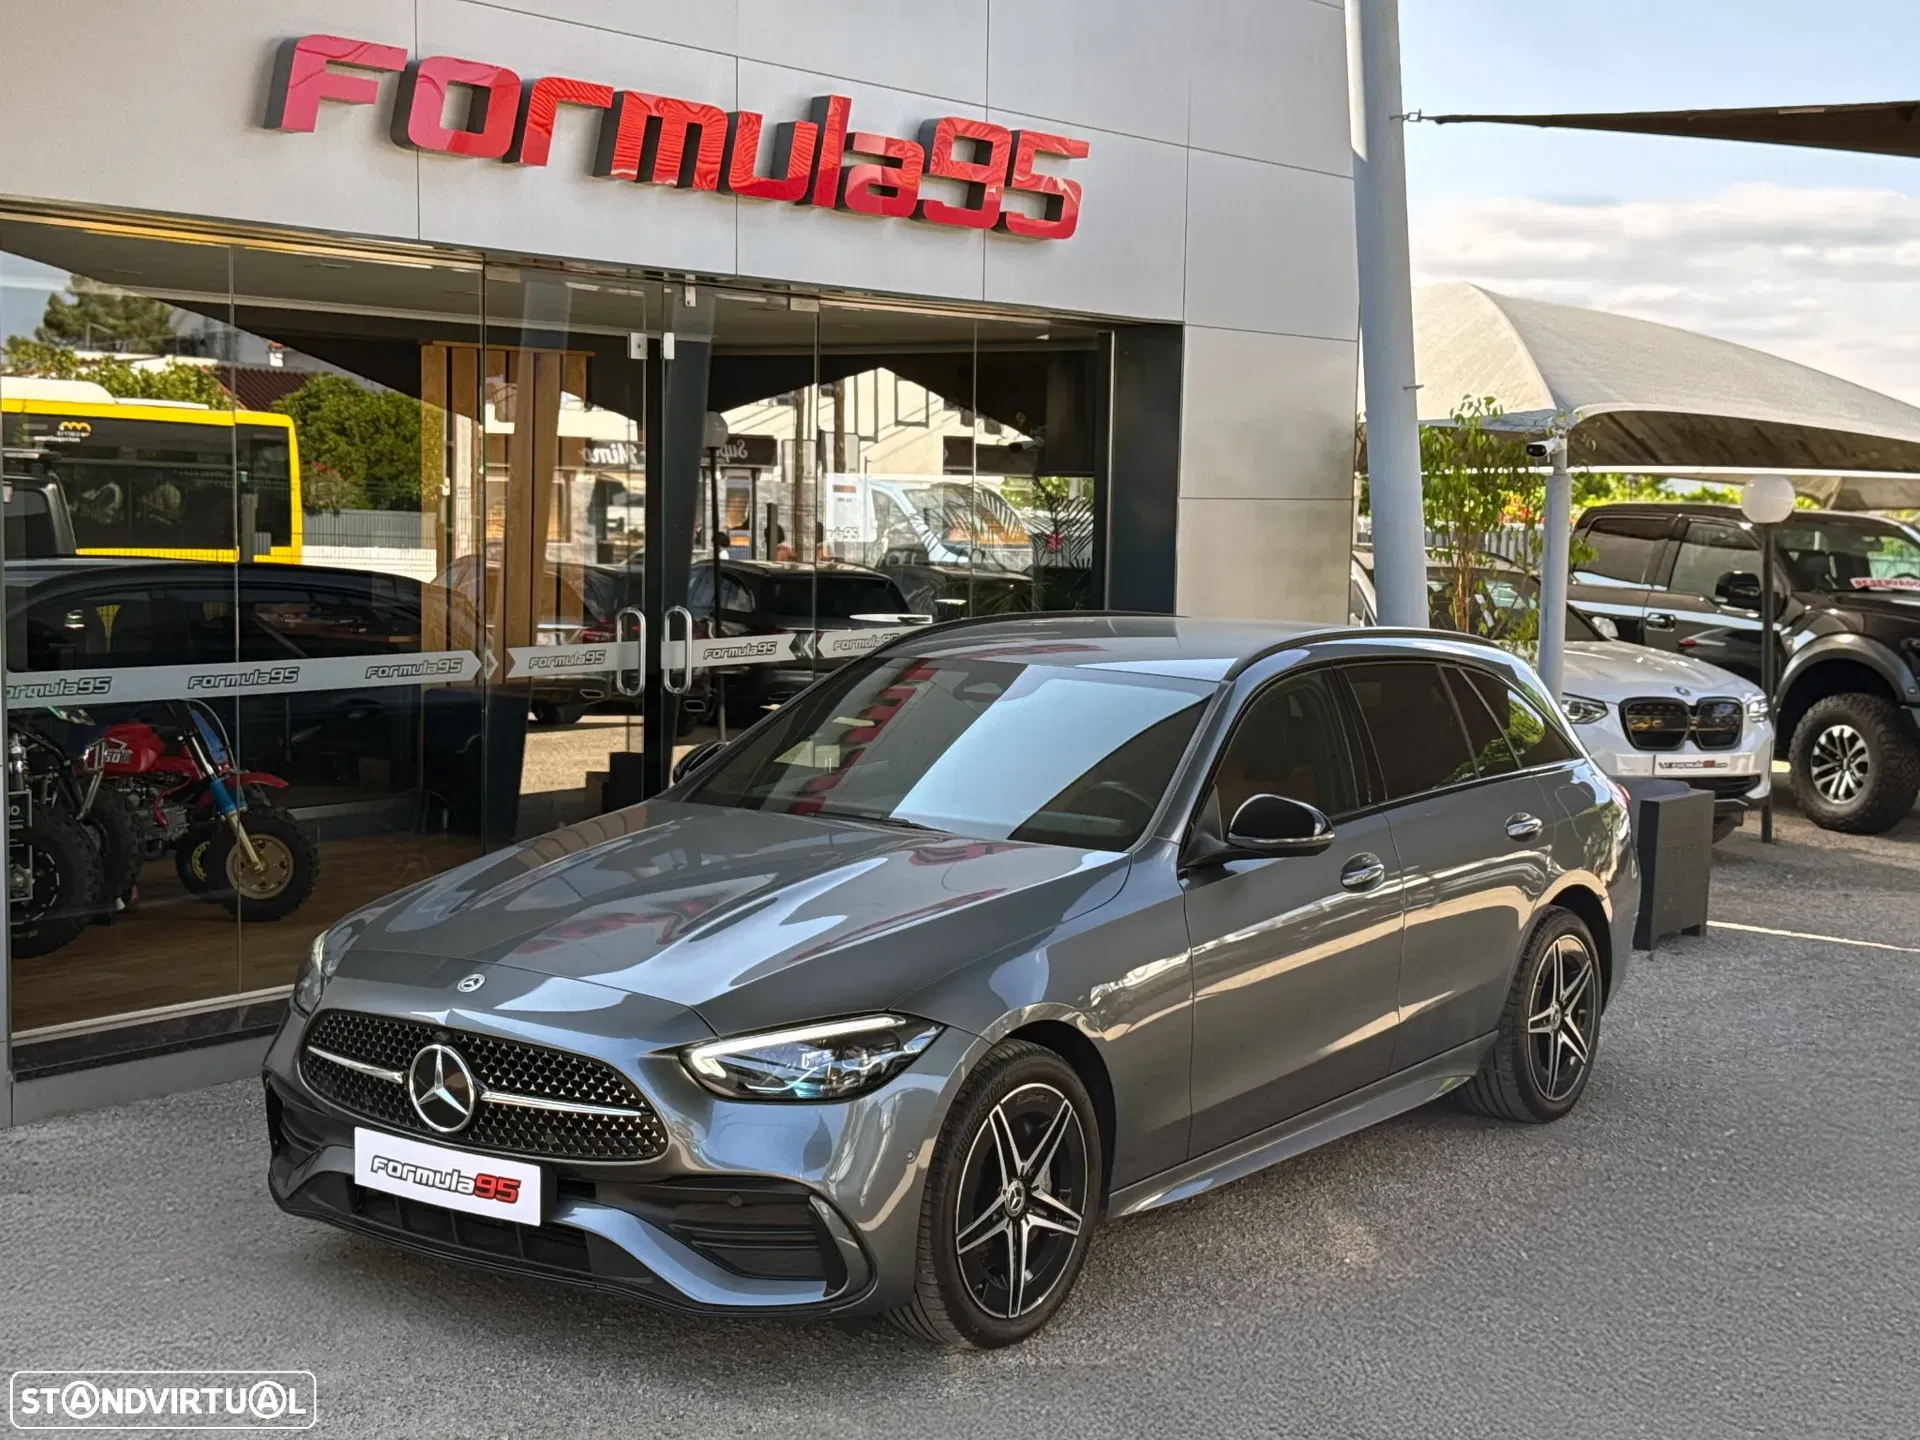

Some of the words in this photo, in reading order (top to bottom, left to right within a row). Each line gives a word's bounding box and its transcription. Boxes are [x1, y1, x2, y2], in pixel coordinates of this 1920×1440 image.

[270, 34, 1089, 240] Formula95
[529, 650, 606, 669] Formula95
[703, 641, 777, 660] Formula95
[187, 665, 300, 691] Formula95
[365, 657, 464, 679] Formula95
[6, 676, 112, 699] ormula95
[370, 1155, 521, 1204] Formula95
